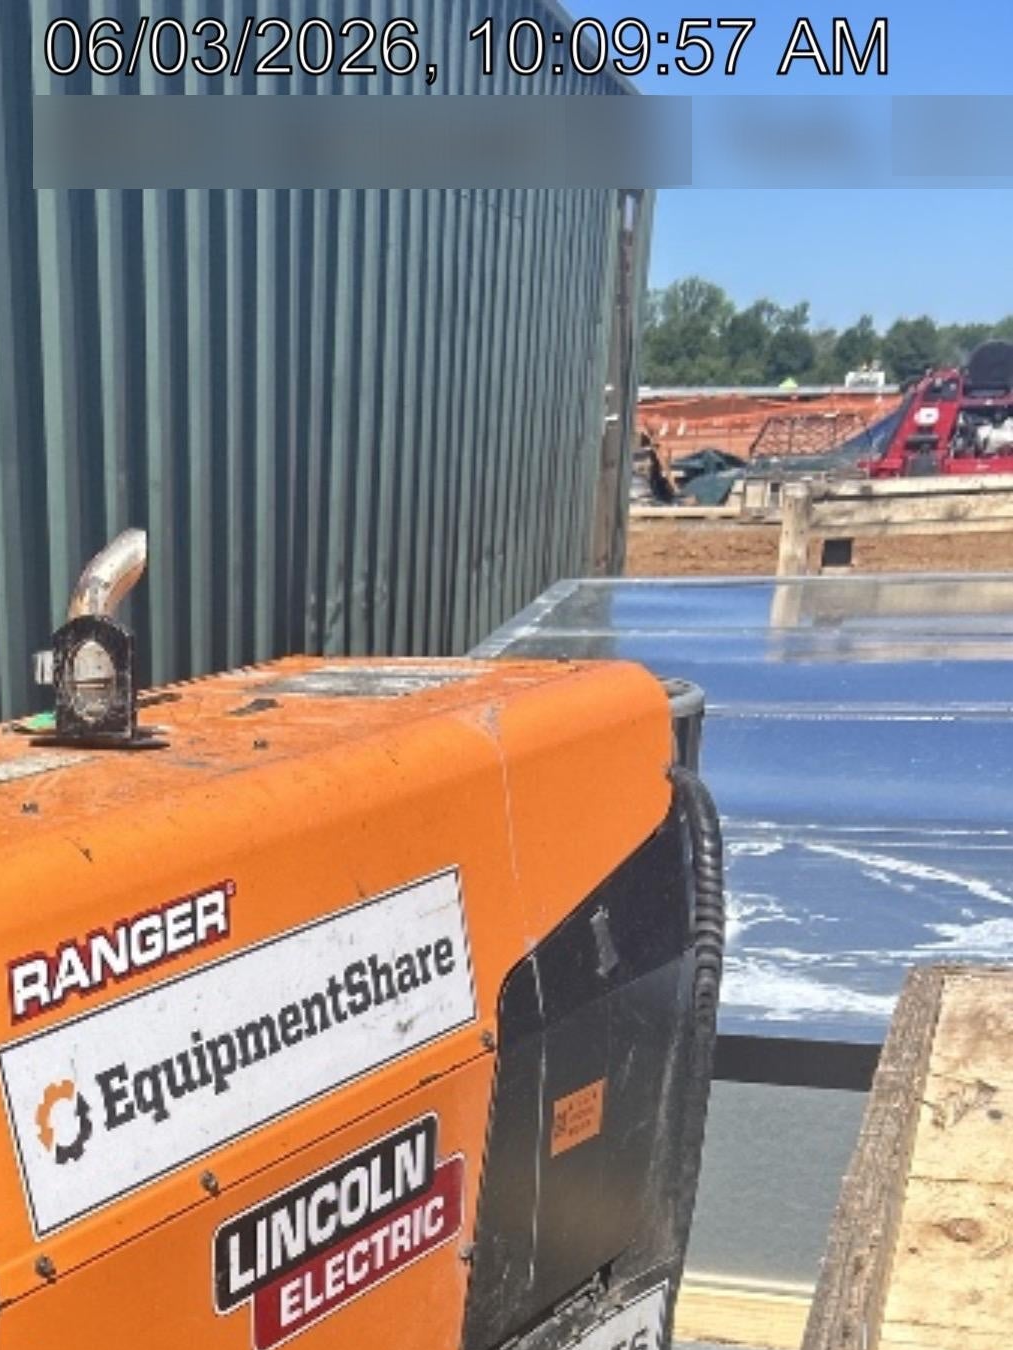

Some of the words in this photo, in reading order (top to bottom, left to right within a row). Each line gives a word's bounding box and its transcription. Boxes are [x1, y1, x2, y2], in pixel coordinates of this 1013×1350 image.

[10, 889, 228, 1017] RANGER
[93, 936, 456, 1131] EquipmentShare
[227, 1131, 427, 1294] LINCOLN
[279, 1196, 445, 1327] ELECTRIC
